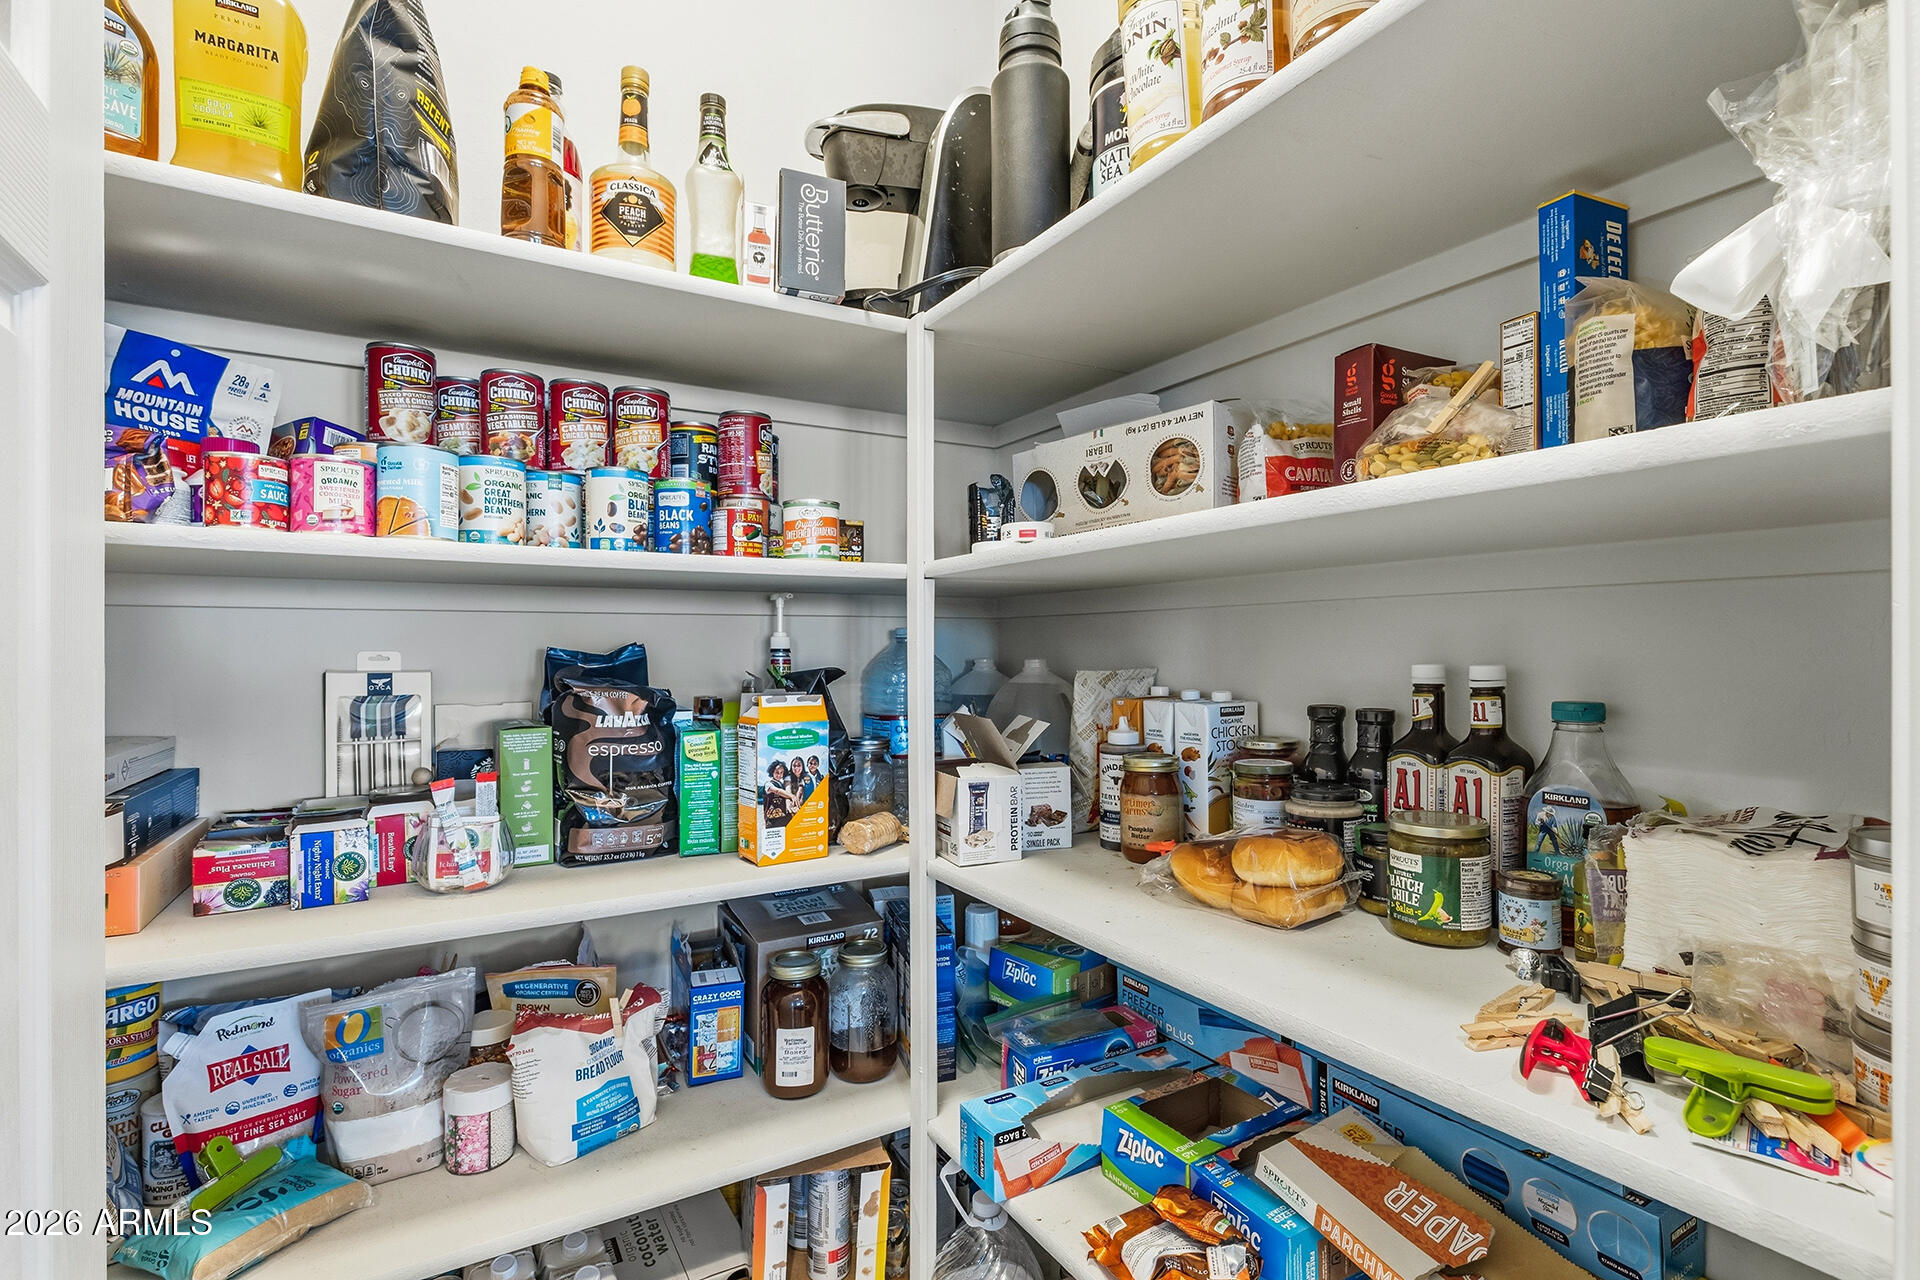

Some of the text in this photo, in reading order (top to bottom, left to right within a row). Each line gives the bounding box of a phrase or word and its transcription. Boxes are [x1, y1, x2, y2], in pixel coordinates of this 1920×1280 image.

[213, 13, 263, 31] PREMIUM
[194, 29, 280, 63] MARGARITA
[1239, 66, 1252, 75] 25.4
[415, 87, 452, 138] ASCENT
[1100, 165, 1124, 185] SEA
[609, 182, 657, 199] CLASSICA
[618, 205, 647, 219] PEACH
[800, 183, 829, 276] Butterie
[1604, 219, 1622, 246] DE
[1521, 315, 1534, 326] Facts
[384, 362, 431, 383] CHUNKY
[231, 373, 250, 390] 28g
[115, 387, 203, 417] MOUNTAIN
[440, 394, 480, 408] CHUNK
[489, 386, 535, 403] CHUNKY
[564, 396, 606, 414] CHUNKY
[617, 404, 656, 417] CHUNKY
[1342, 397, 1362, 409] Small
[114, 400, 201, 434] HOUSE
[1342, 406, 1362, 418] Shells
[487, 421, 527, 431] VEGETABLE
[561, 424, 606, 432] CREAMY
[1125, 410, 1204, 436] NET WT. 4.6 LB (2.1 kg)
[1085, 443, 1113, 458] DI BARI
[1293, 441, 1333, 452] SPROUTS
[319, 464, 360, 477] SPROUTS
[484, 468, 519, 478] SPROUTS
[320, 477, 358, 488] ORGANIC
[484, 479, 523, 491] ORGANIC
[484, 487, 511, 498] GREAT
[484, 497, 524, 509] NORTHERN
[484, 506, 512, 516] BEANS
[659, 509, 694, 522] BLACK
[659, 521, 680, 530] BEANS
[794, 518, 824, 530] Organic
[368, 684, 392, 692] ORCA
[1472, 701, 1489, 723] A1
[1211, 724, 1256, 739] CHICKEN
[588, 740, 663, 757] espresso
[657, 780, 672, 788] COFFEE
[1393, 767, 1424, 811] A1
[1452, 775, 1483, 821] A1
[1544, 792, 1589, 806] KIRKLAND
[1010, 786, 1018, 851] PROTEIN BAR
[1127, 824, 1154, 833] Pumpkin
[1131, 832, 1150, 840] Butter
[1026, 838, 1061, 848] SINGLE PACK
[386, 831, 396, 872] Breathe Easy
[585, 853, 602, 862] WEIGHT
[211, 860, 277, 873] Echinacea Plus
[312, 839, 322, 881] Nighty Night
[1390, 853, 1420, 866] SPROUTS
[229, 871, 256, 879] ORGANIC
[1389, 873, 1425, 895] HATCH
[1391, 887, 1420, 907] CHILE
[1395, 901, 1415, 916] Salsa
[808, 932, 845, 945] KIRKLAND
[863, 927, 879, 939] 72
[1006, 960, 1037, 988] Ziploc
[1123, 975, 1149, 994] KIRKLAND
[692, 989, 741, 1001] CRAZY GOOD
[106, 996, 158, 1025] ARGO
[516, 1003, 550, 1012] BROWN
[1122, 988, 1165, 1019] FREEZER
[215, 1016, 276, 1041] Redmond
[1145, 1029, 1157, 1038] 120
[1165, 1023, 1195, 1046] PLUS
[588, 1035, 615, 1056] ORGANIC
[1136, 1037, 1157, 1049] SNACK
[329, 1041, 380, 1061] organics
[211, 1047, 288, 1088] REAL SALT
[575, 1062, 605, 1082] BREAD
[605, 1050, 625, 1071] FLOUR
[1250, 1057, 1278, 1069] KIRKLAND
[332, 1065, 389, 1085] Powdered
[241, 1092, 273, 1105] UNREFINED
[331, 1086, 363, 1099] Sugar
[1319, 1076, 1327, 1114] 32 BAGS
[1334, 1079, 1379, 1108] KIRKLAND
[193, 1106, 220, 1118] AMAZING
[242, 1100, 266, 1111] MINERAL
[193, 1114, 213, 1123] TASTE
[239, 1122, 253, 1130] FOR
[255, 1112, 286, 1126] EVERYDAY
[287, 1107, 299, 1115] USE
[243, 1110, 308, 1138] FINE SEA SALT
[998, 1129, 1020, 1144] BAGS
[1117, 1128, 1165, 1168] Ziploc
[1104, 1169, 1139, 1198] SANDWICH
[1262, 1164, 1308, 1208] SPROUTS
[1281, 1220, 1298, 1231] 54
[1671, 1216, 1698, 1242] KIRKLAND
[626, 1215, 656, 1268] coconut
[645, 1218, 669, 1256] water
[619, 1230, 637, 1263] organic
[1671, 1233, 1699, 1257] FREEZER
